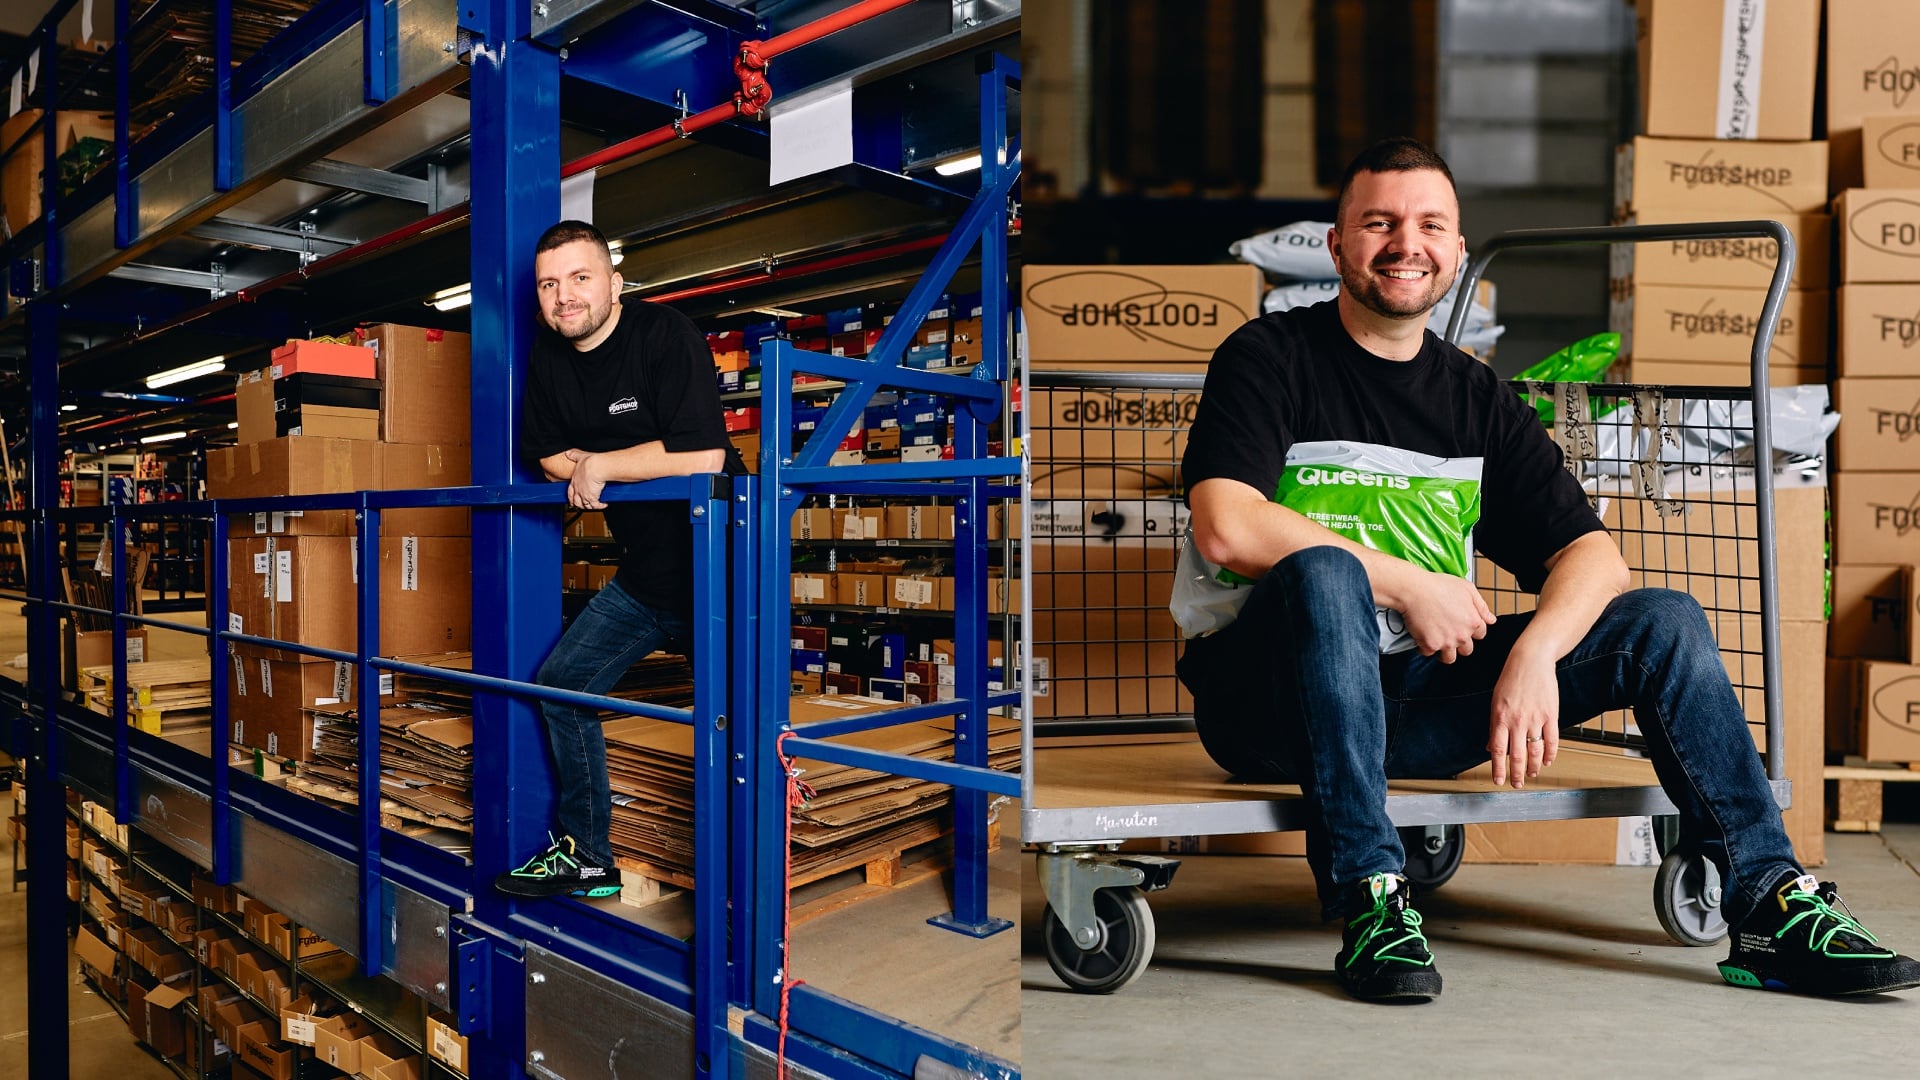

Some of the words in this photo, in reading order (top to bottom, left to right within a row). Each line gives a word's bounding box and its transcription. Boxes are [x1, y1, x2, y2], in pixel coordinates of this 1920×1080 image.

[1863, 68, 1920, 93] FOO
[1669, 163, 1793, 187] FOOTSHOP
[1881, 223, 1920, 246] FO
[1672, 239, 1778, 261] FOOTSHO
[1062, 303, 1219, 327] FOOTSHOP
[1670, 312, 1794, 336] FOOTSHP
[1881, 318, 1920, 341] FO
[1063, 399, 1200, 425] OOTSHOP
[1296, 467, 1411, 490] Queens
[1146, 519, 1157, 531] Q
[1331, 521, 1353, 529] HEAD
[1355, 522, 1366, 530] TO
[1368, 523, 1386, 532] TOE.
